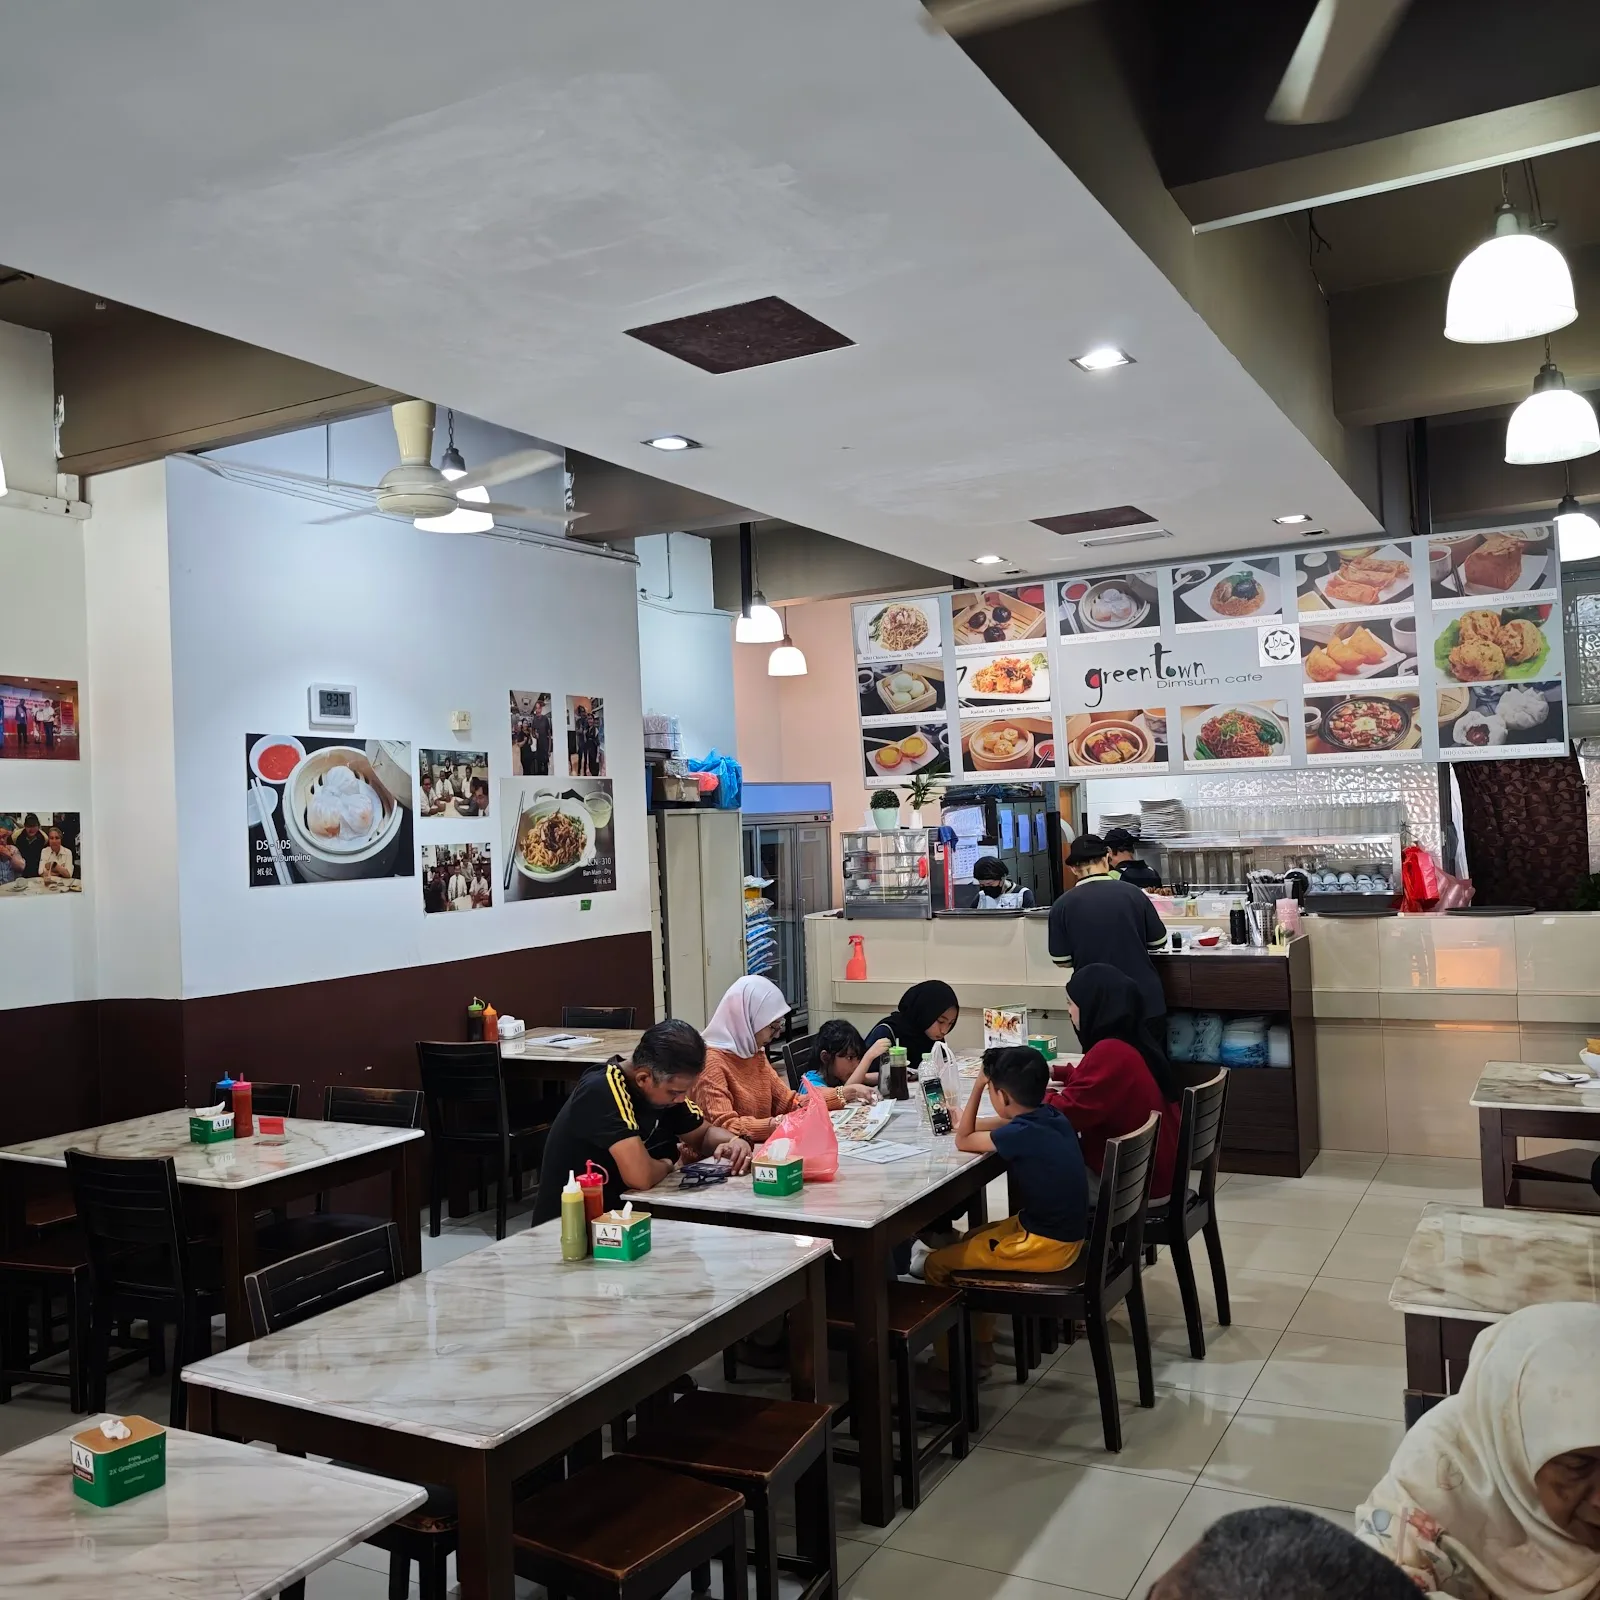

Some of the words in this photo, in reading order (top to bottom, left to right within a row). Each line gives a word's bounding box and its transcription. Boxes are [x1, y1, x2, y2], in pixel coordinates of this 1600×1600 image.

[1156, 678, 1220, 689] Dimsum
[1224, 673, 1263, 684] cafe
[256, 840, 268, 850] DS
[276, 840, 290, 850] 105
[256, 854, 278, 863] Prawn
[279, 853, 311, 863] Dumpling
[602, 857, 611, 866] 310
[601, 1228, 608, 1237] A
[612, 1228, 617, 1237] 7
[76, 1450, 82, 1465] A
[85, 1454, 90, 1468] 6
